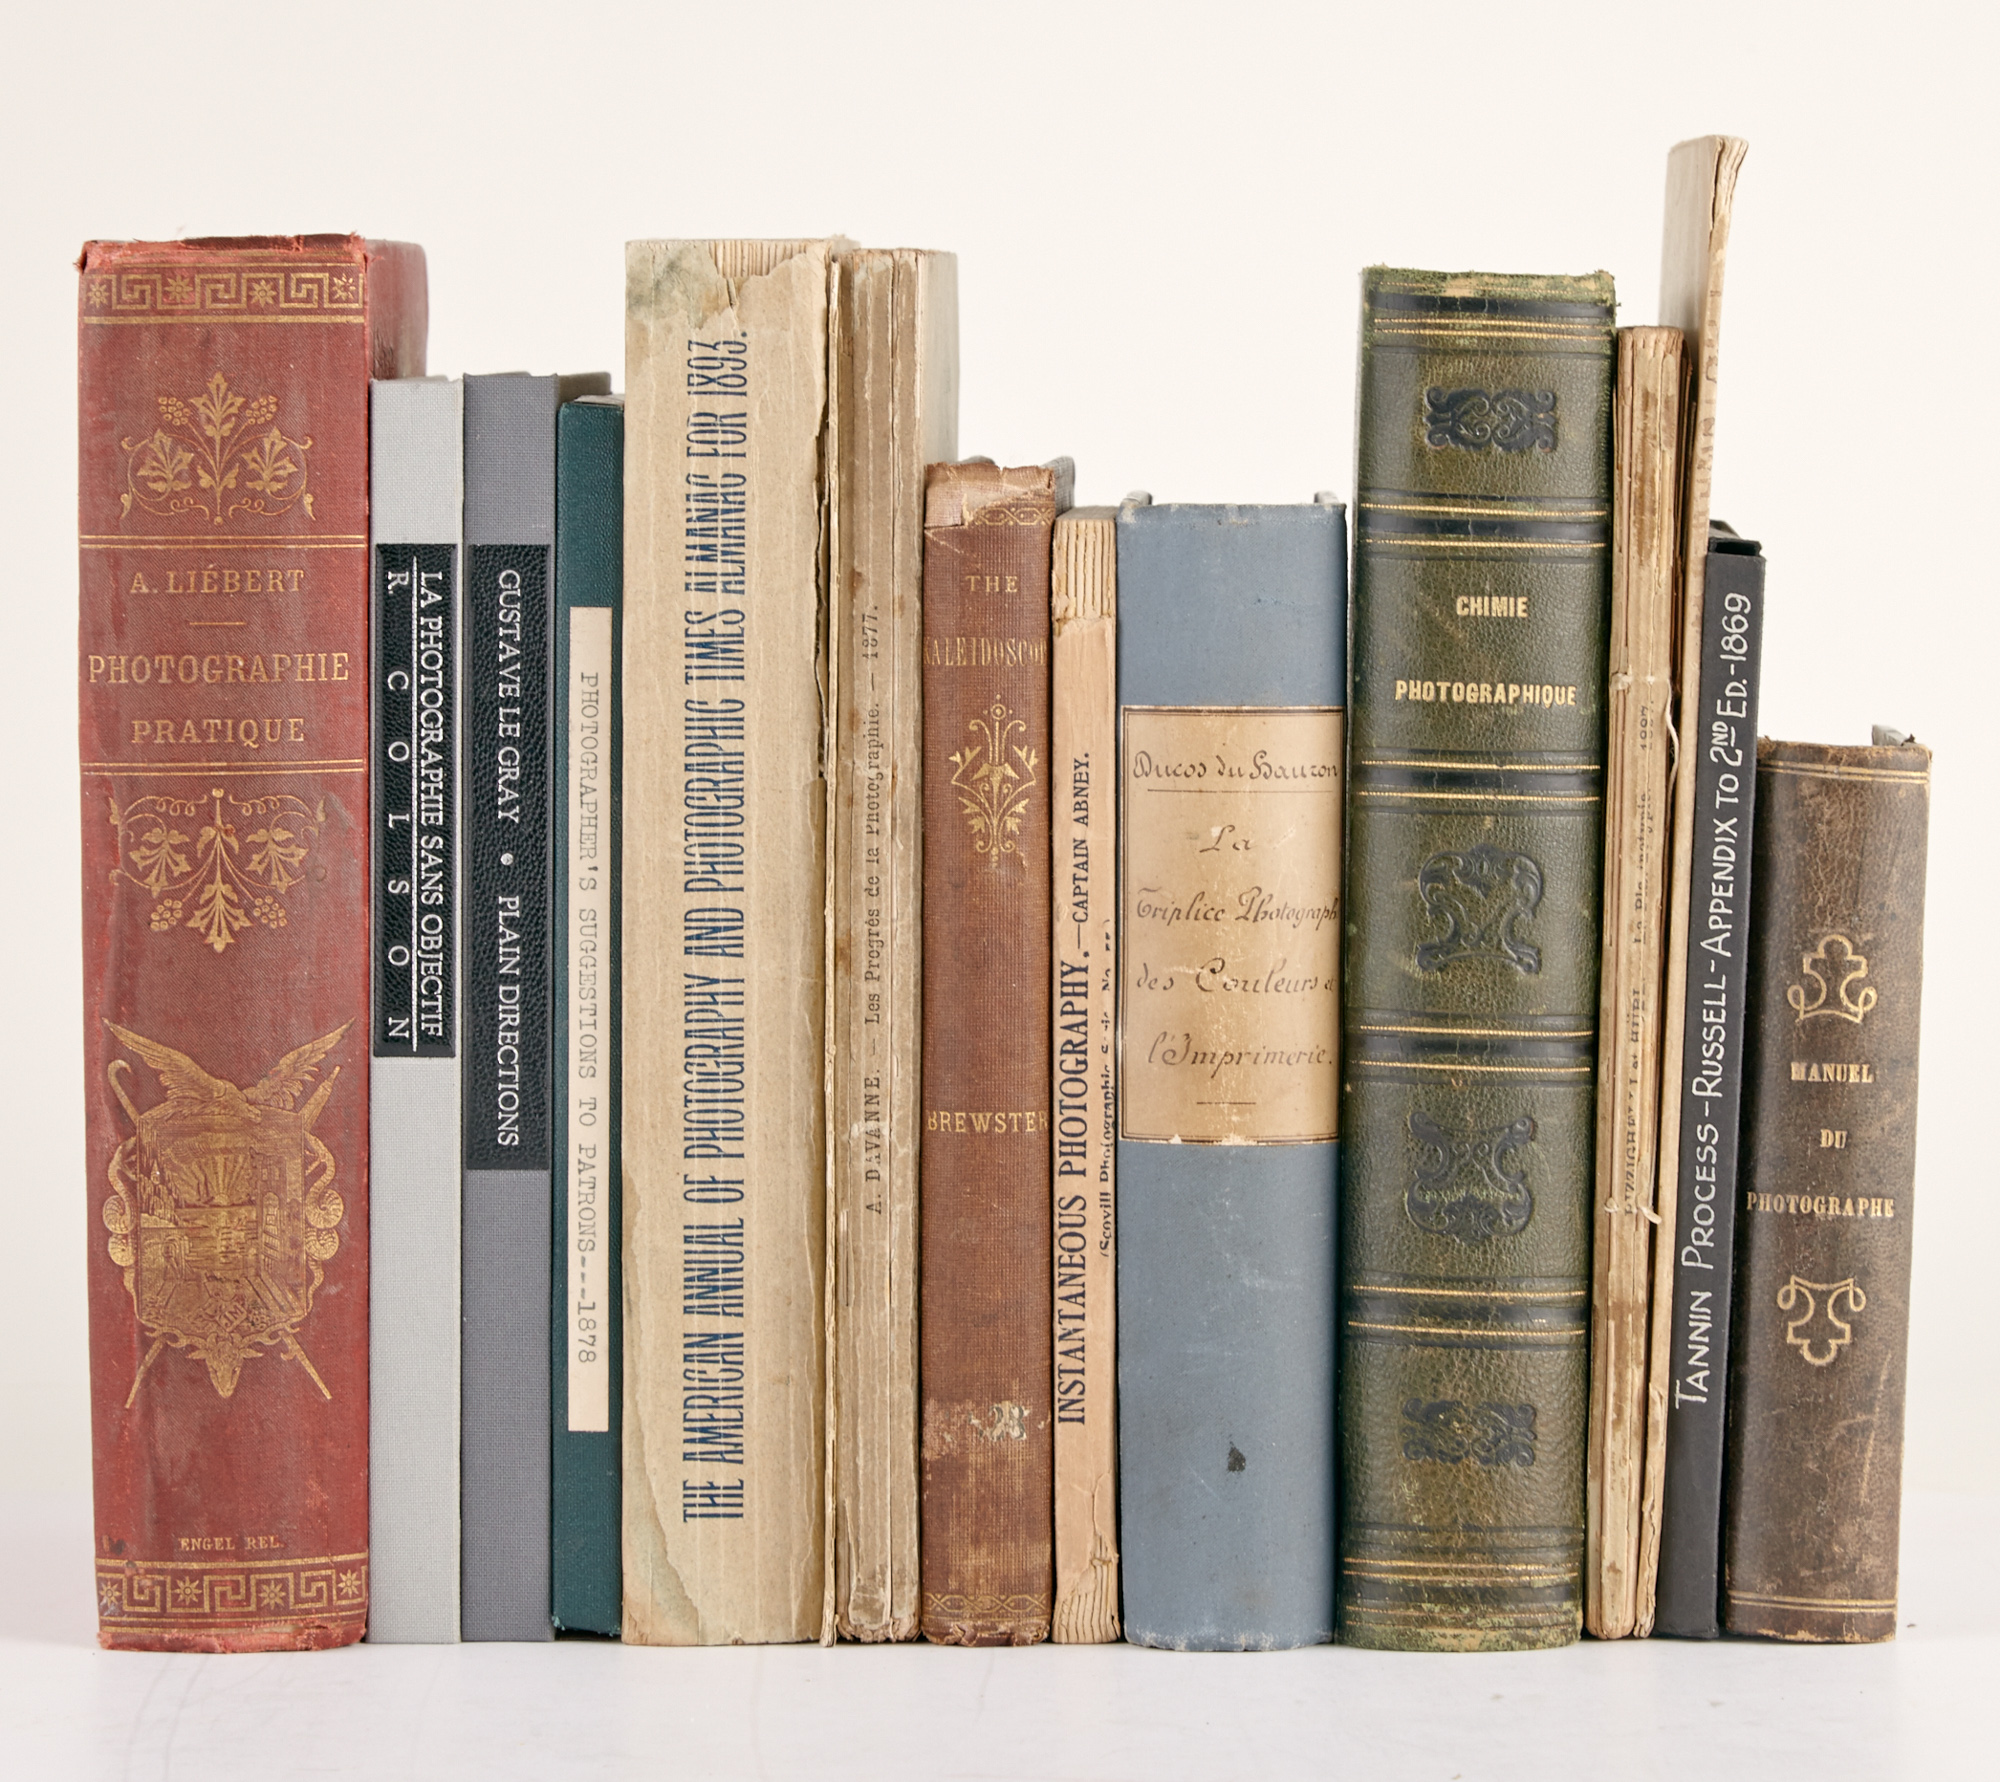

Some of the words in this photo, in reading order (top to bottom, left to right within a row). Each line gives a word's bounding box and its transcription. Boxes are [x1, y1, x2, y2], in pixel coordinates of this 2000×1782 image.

[687, 330, 749, 398] 1893.
[686, 411, 748, 458] FOR
[685, 472, 748, 595] ALMANAC
[130, 572, 158, 593] A.
[165, 563, 305, 593] LIÉBERT
[420, 570, 443, 608] LA
[965, 575, 1018, 592] THE
[1456, 596, 1529, 618] CHIMIE
[498, 568, 521, 699] GUSTAVE
[685, 608, 746, 685] TIMES
[87, 652, 349, 683] PHOTOGRAPHIE
[1394, 679, 1577, 708] PHOTOGRAPHIQUE
[131, 718, 305, 748] PRATIQUE
[420, 615, 444, 827] PHOTOGRAPHIE
[498, 706, 521, 738] LE
[1132, 750, 1207, 778] Ducos
[1215, 754, 1245, 777] du
[1249, 749, 1338, 780] Hauron
[1709, 720, 1744, 767] 2ND
[497, 746, 520, 824] GRAY
[579, 672, 600, 892] PHOTOGRAPHER'S
[863, 702, 885, 836] Photographie.
[684, 698, 746, 893] PHOTOGRAPHIC
[1715, 773, 1739, 810] TO
[863, 847, 880, 865] la
[1199, 824, 1251, 853] La
[420, 834, 444, 905] SANS
[864, 874, 881, 899] de
[1136, 886, 1226, 926] Triplice
[498, 895, 520, 976] PLAIN
[683, 907, 745, 959] AND
[418, 913, 443, 1037] OBJECTIF
[578, 908, 598, 1080] SUGGESTIONS
[1136, 962, 1175, 991] des
[1195, 957, 1318, 993] Couleurs
[865, 992, 881, 1025] Les
[497, 985, 519, 1146] DIRECTIONS
[683, 973, 746, 1159] PHOTOGRAPHY
[1147, 1031, 1333, 1079] l'Imprimerie.
[1790, 1062, 1874, 1083] MANUEL
[1057, 1194, 1087, 1425] INSTANTANEOUS
[1073, 751, 1090, 827] ABNEY.
[578, 1097, 597, 1127] TO
[926, 1110, 1048, 1133] BREWSTER
[1820, 1128, 1847, 1149] DU
[683, 1174, 745, 1204] OF
[865, 1193, 882, 1215] A.
[1747, 1191, 1894, 1218] PHOTOGRAPHE
[683, 1217, 745, 1318] ANNUAL
[1675, 1290, 1713, 1410] TANNIN
[683, 1332, 745, 1465] AMERICAN
[683, 1478, 745, 1523] THE
[178, 1536, 236, 1552] ENGEL
